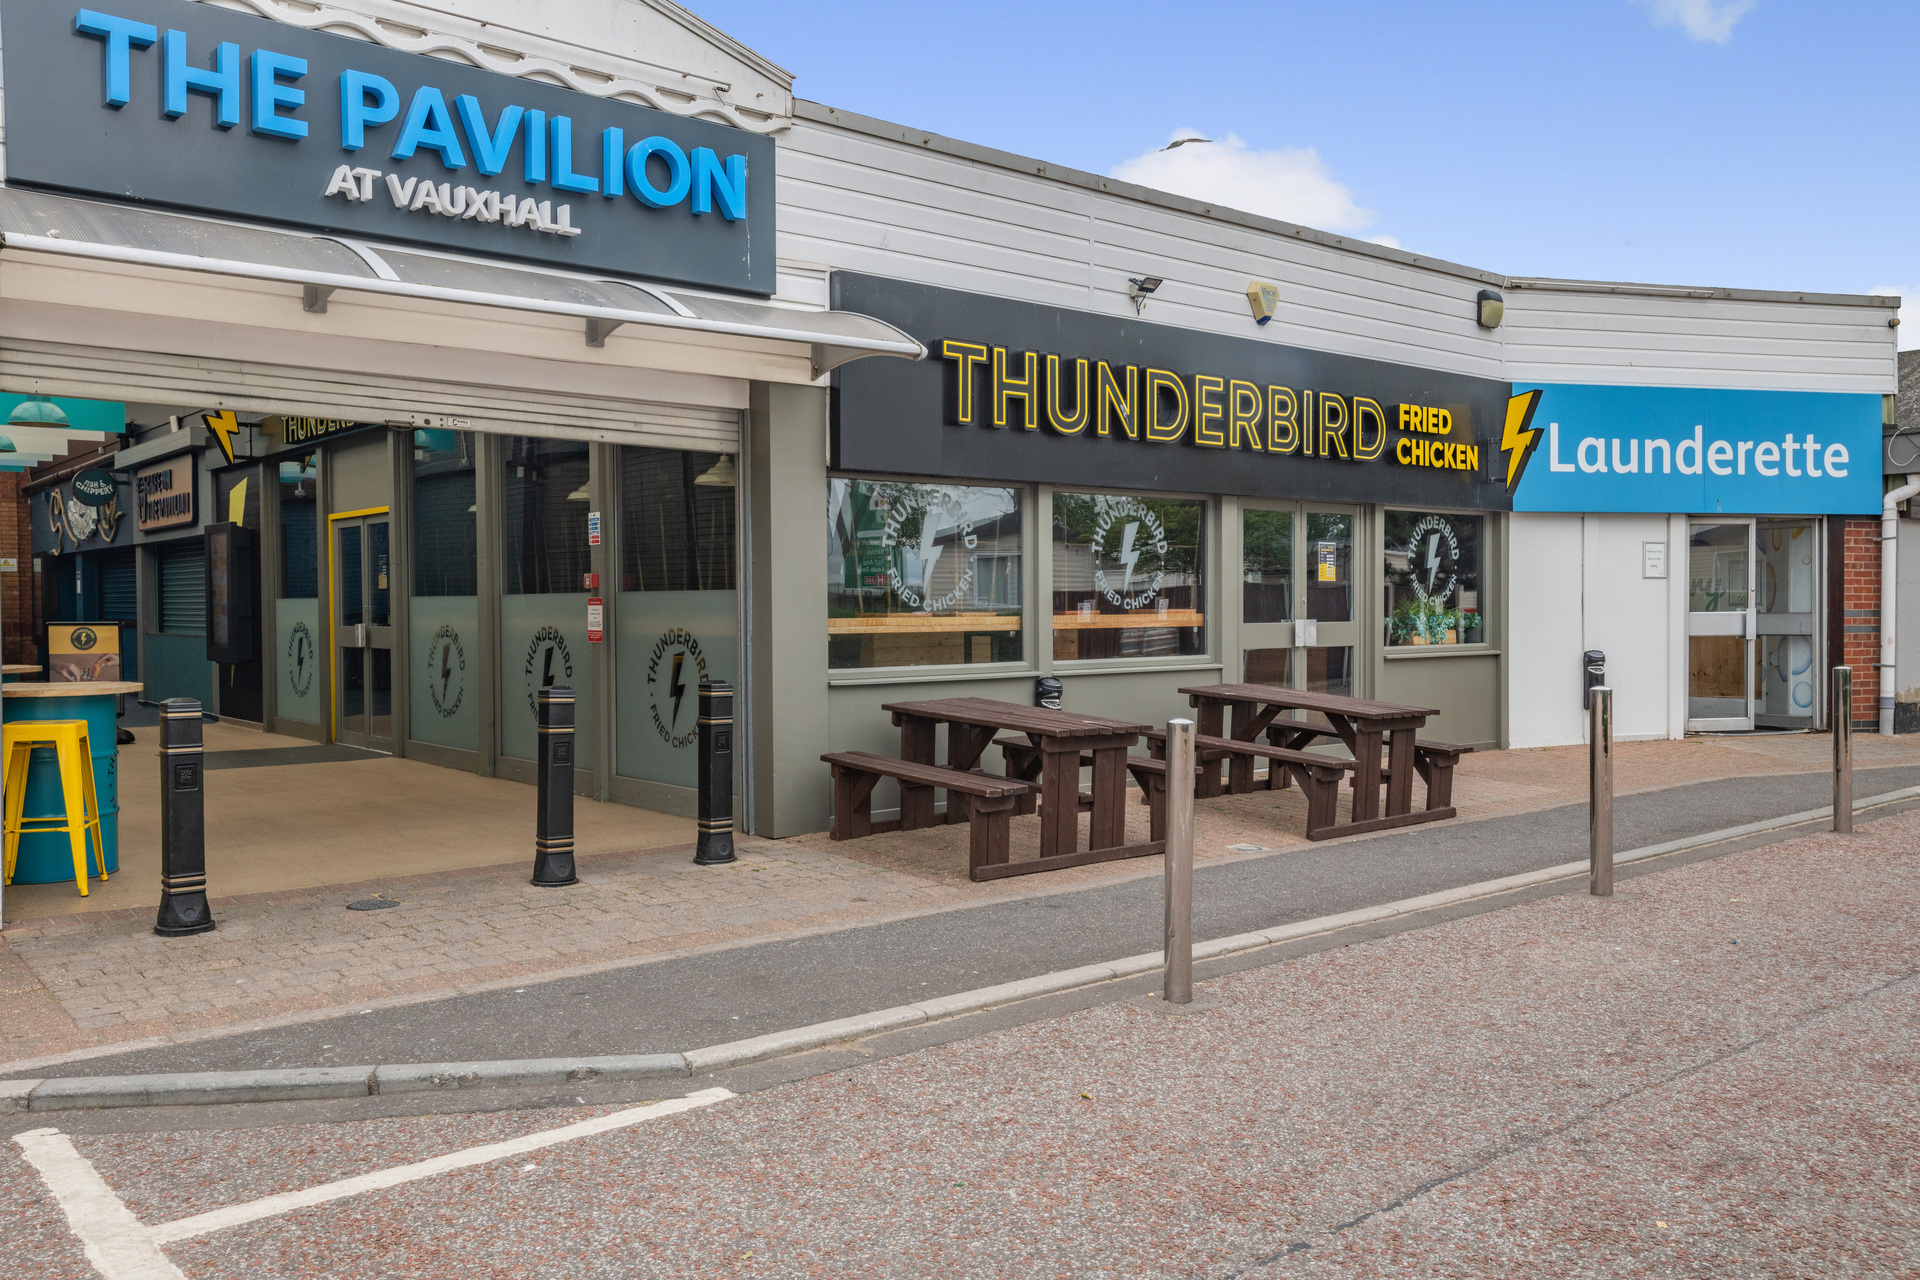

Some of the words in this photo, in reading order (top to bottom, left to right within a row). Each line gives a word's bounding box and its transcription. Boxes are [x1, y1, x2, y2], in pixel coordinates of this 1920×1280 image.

[76, 8, 309, 141] THE
[340, 69, 747, 222] PAVILION
[324, 165, 382, 203] AT
[385, 173, 582, 237] VAUXHALL
[942, 338, 1389, 463] THUNDERBIRD
[1399, 403, 1452, 435] FRIED
[1396, 437, 1479, 471] CHICKEN
[1550, 422, 1849, 478] Launderette
[75, 481, 114, 496] CHIPPERY
[83, 479, 99, 489] FISH
[882, 489, 977, 549] THUNDERBIRD
[1092, 500, 1168, 554] THUNDERBIRD
[1407, 516, 1459, 560] THUNDERBIRD
[887, 567, 920, 608] FRIED
[923, 568, 974, 612] CHICKEN
[1096, 570, 1121, 606] FRIED
[1124, 570, 1164, 610] CHICKEN
[1410, 573, 1428, 602] FRIED
[1429, 574, 1457, 606] CHICKEN
[288, 621, 313, 659] THUNDERBIRD
[428, 624, 466, 671] THUNDERBIRD
[525, 625, 572, 678] THUNDERBIRD
[429, 683, 443, 714] FRIED
[442, 686, 464, 718] CHICKEN
[528, 692, 539, 722] FRIE
[650, 704, 670, 743] FRIED
[672, 719, 700, 749] CHICK
